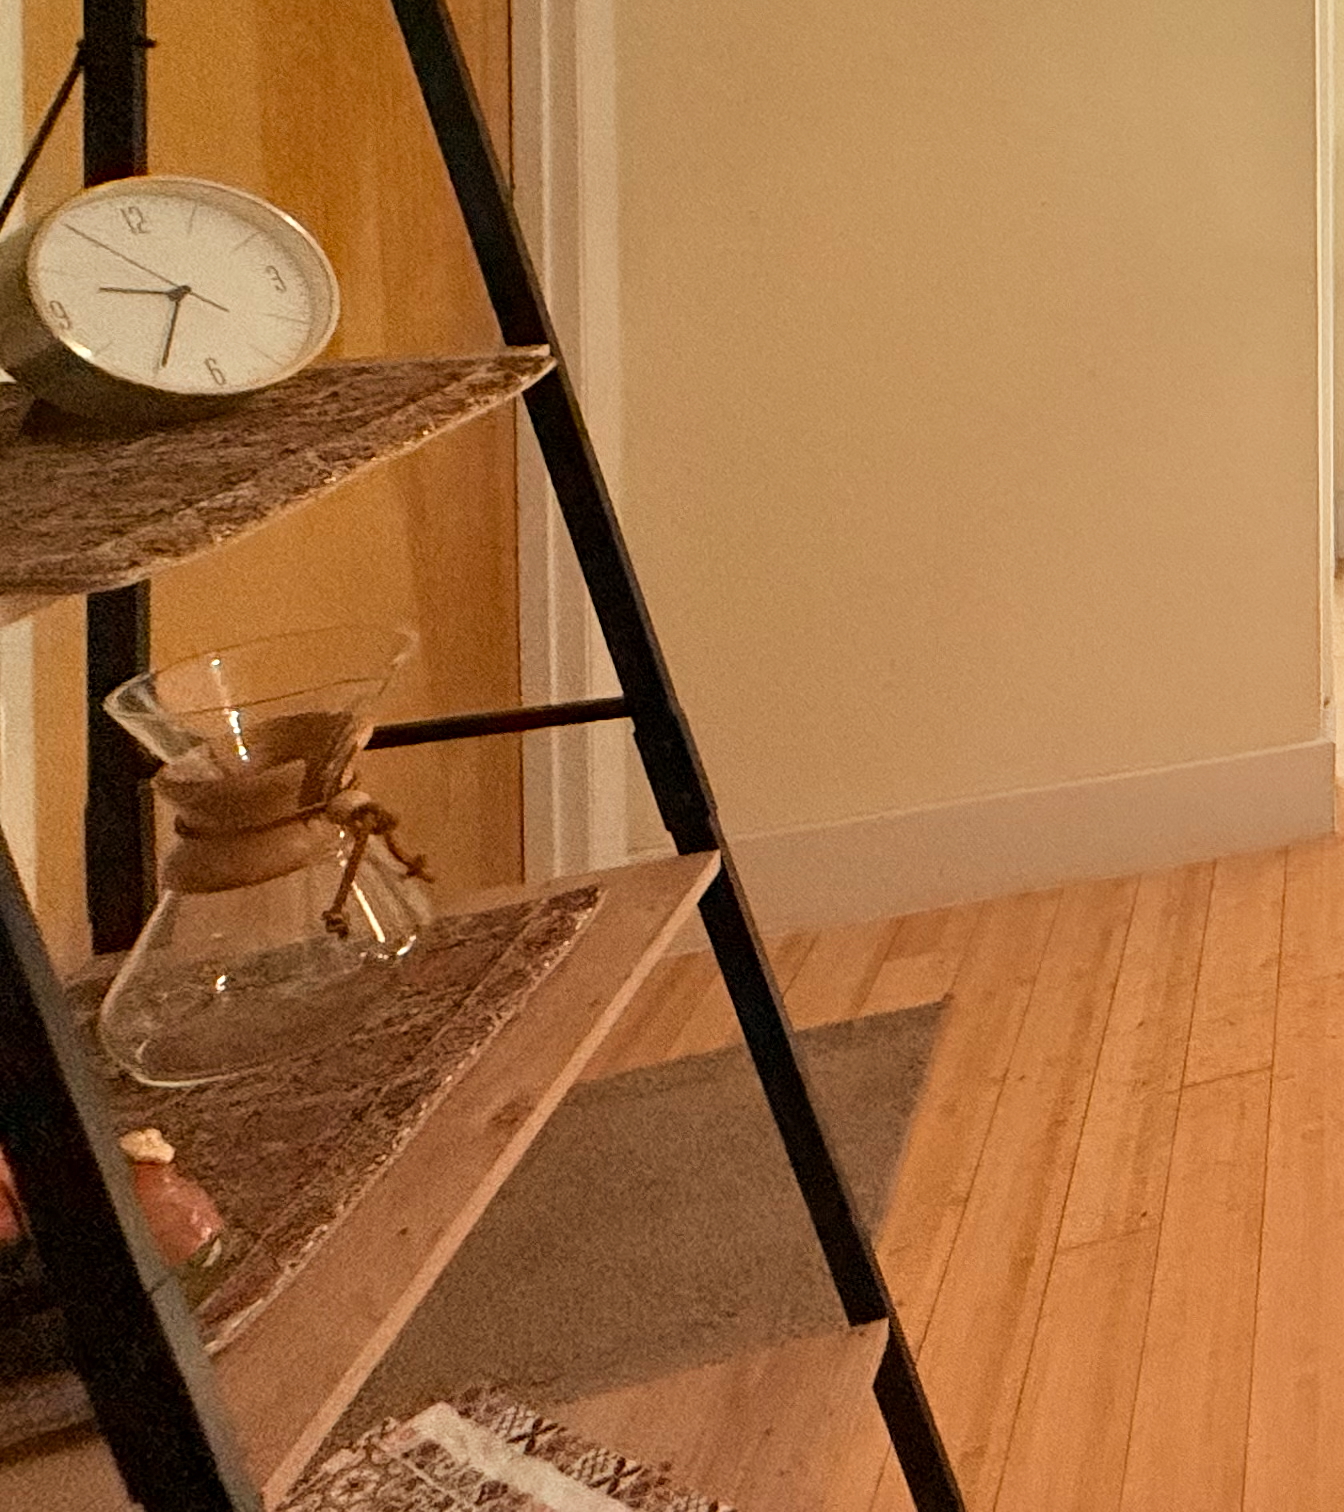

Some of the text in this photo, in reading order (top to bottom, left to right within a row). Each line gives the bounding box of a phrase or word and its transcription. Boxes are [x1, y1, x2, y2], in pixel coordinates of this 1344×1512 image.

[120, 205, 150, 236] 12
[266, 265, 287, 293] 3
[50, 300, 72, 330] 9
[204, 357, 227, 386] 6
